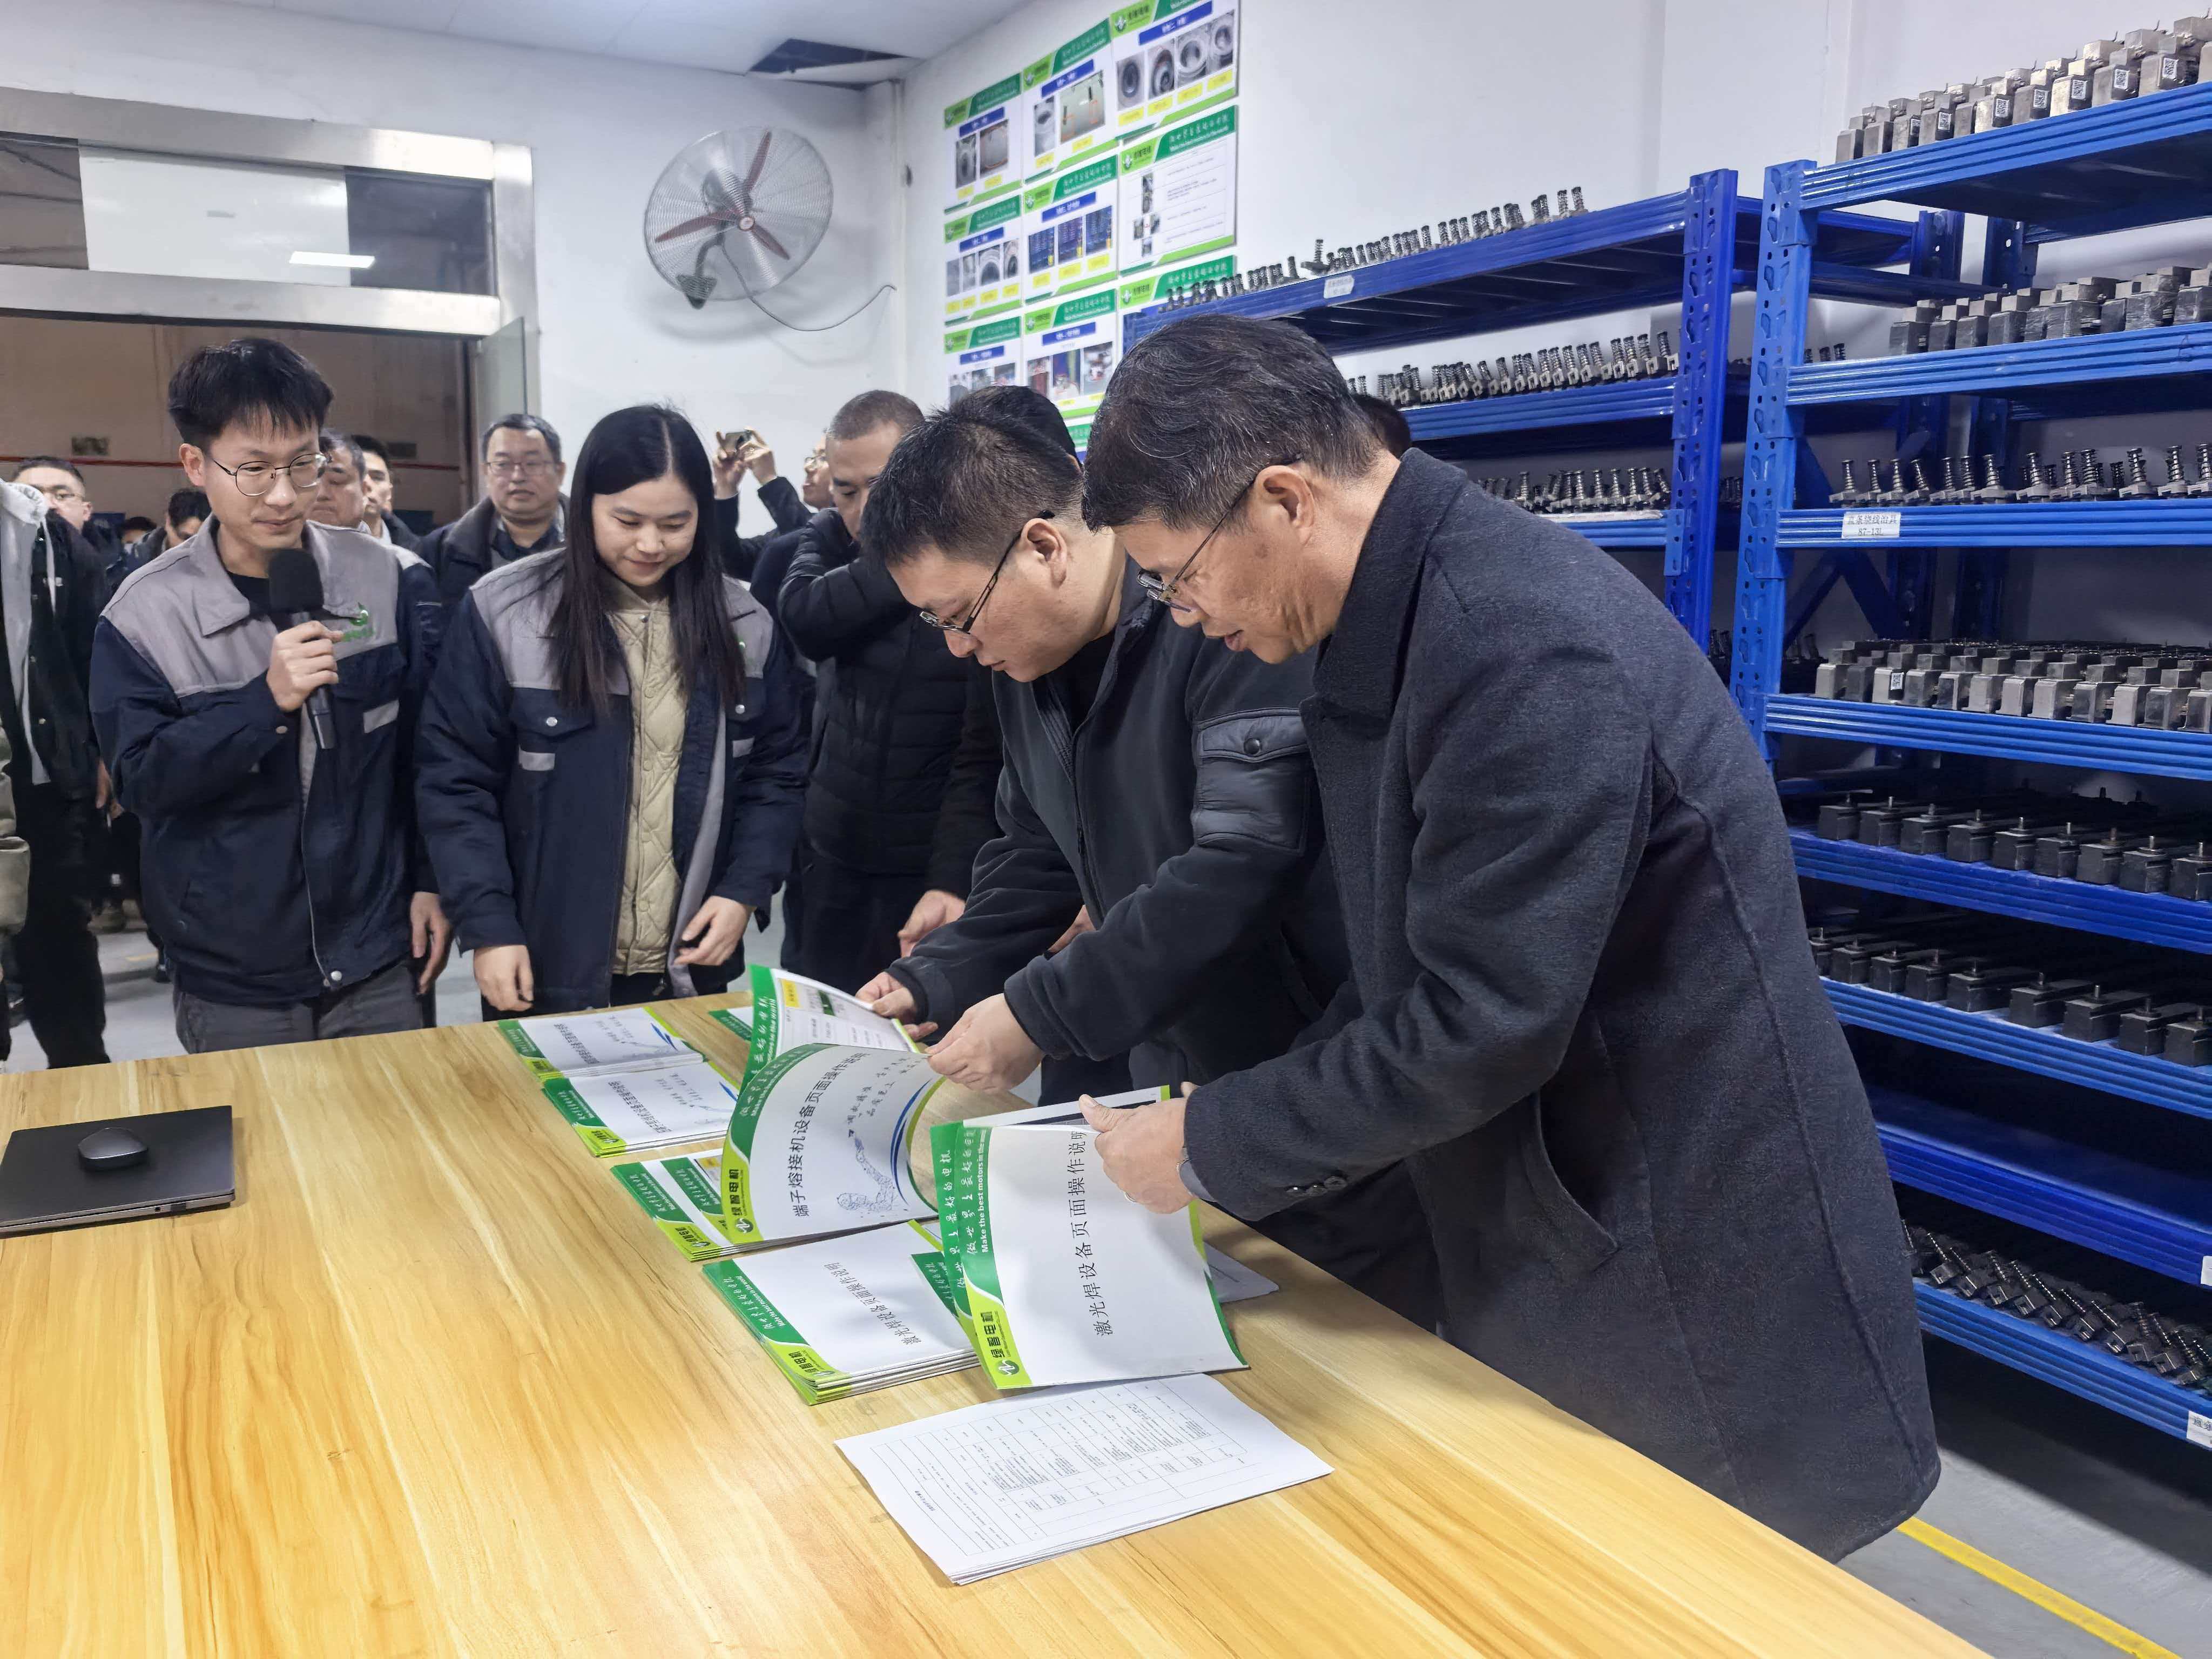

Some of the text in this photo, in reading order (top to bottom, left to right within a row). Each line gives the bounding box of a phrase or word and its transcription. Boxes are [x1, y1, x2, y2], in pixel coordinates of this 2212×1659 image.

[789, 1053, 871, 1218] 端子熔接机设备页面操作说明
[980, 1229, 988, 1252] Make
[1067, 1130, 1114, 1336] 激光焊设备页面操作说明
[823, 1262, 922, 1345] 激光焊设备页面操作说明
